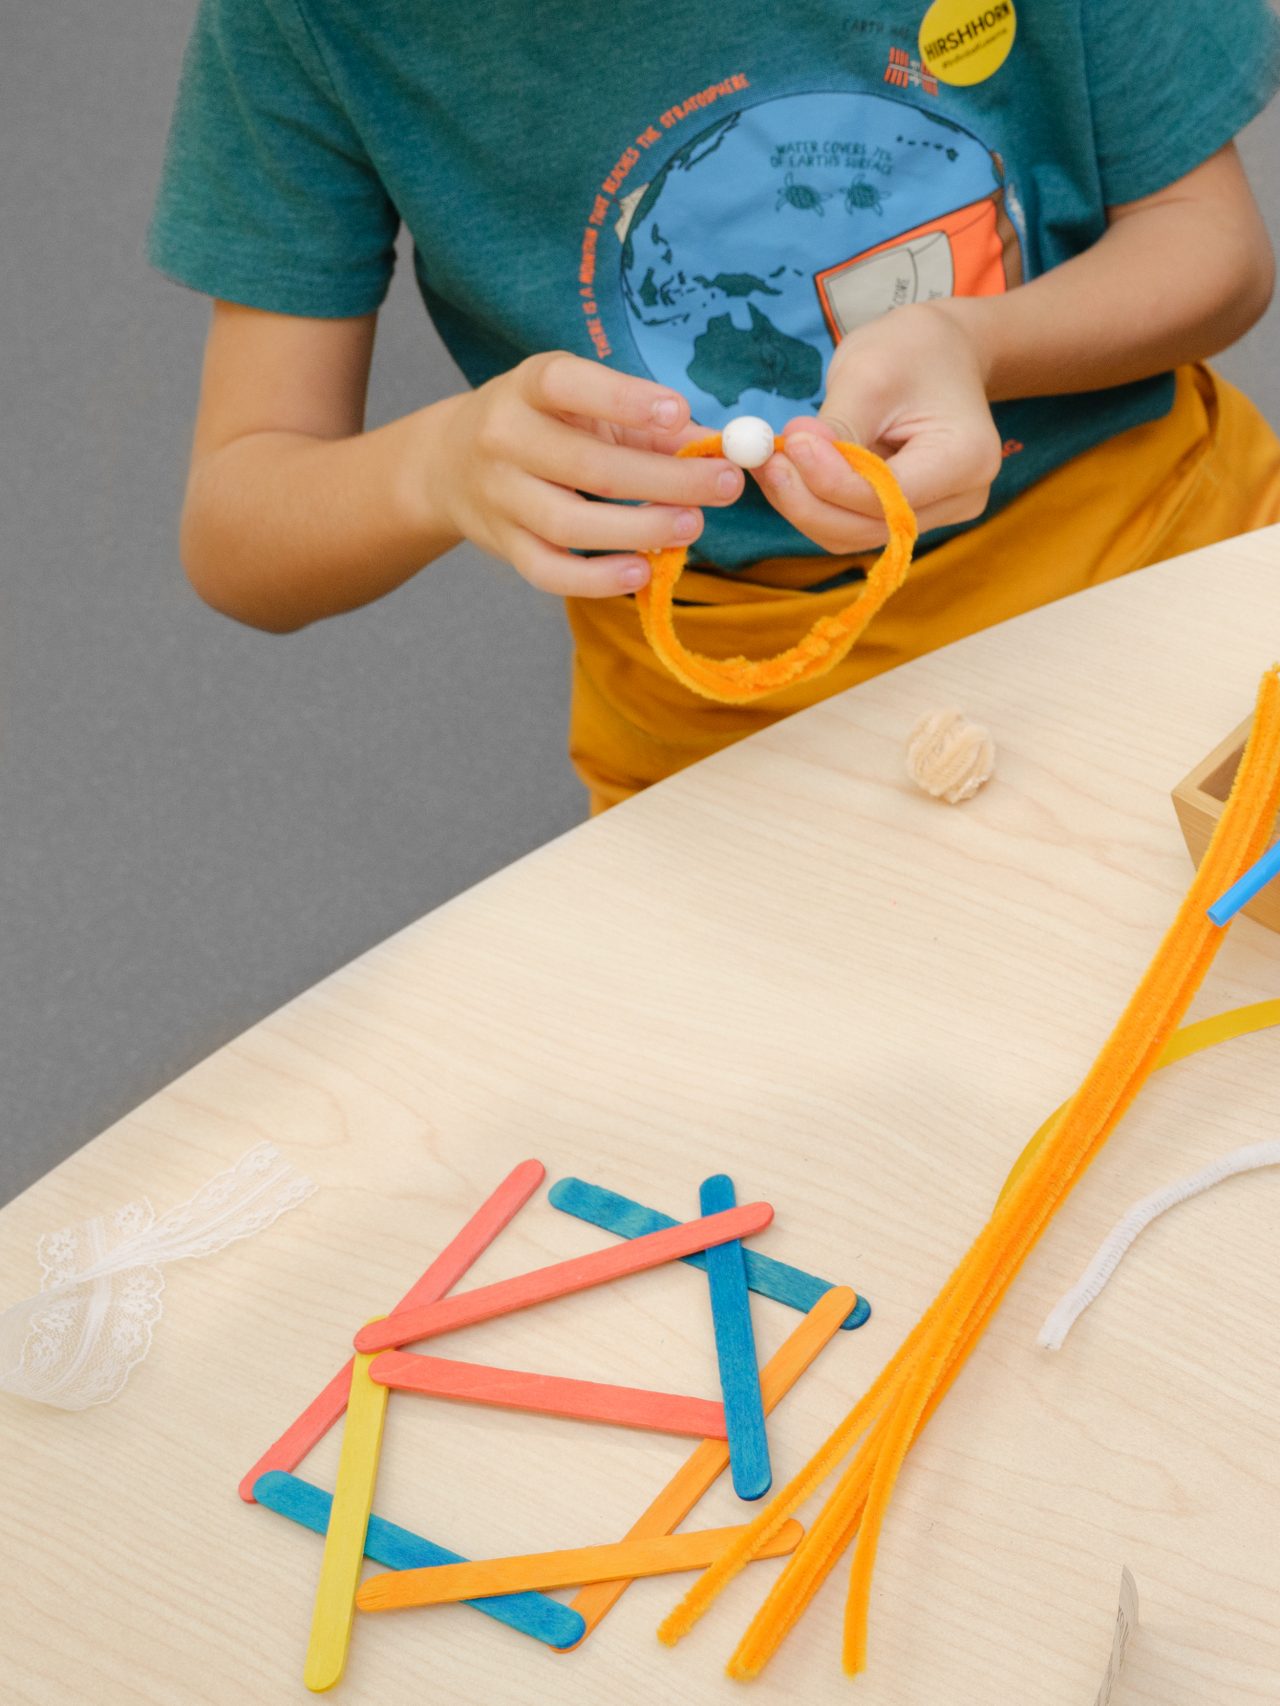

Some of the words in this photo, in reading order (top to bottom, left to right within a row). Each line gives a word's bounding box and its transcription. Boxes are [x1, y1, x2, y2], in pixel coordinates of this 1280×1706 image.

[923, 2, 1012, 62] HIRSHHORN
[775, 140, 818, 154] WATER
[822, 141, 865, 155] COVERS
[769, 156, 783, 168] OF
[579, 287, 594, 298] A
